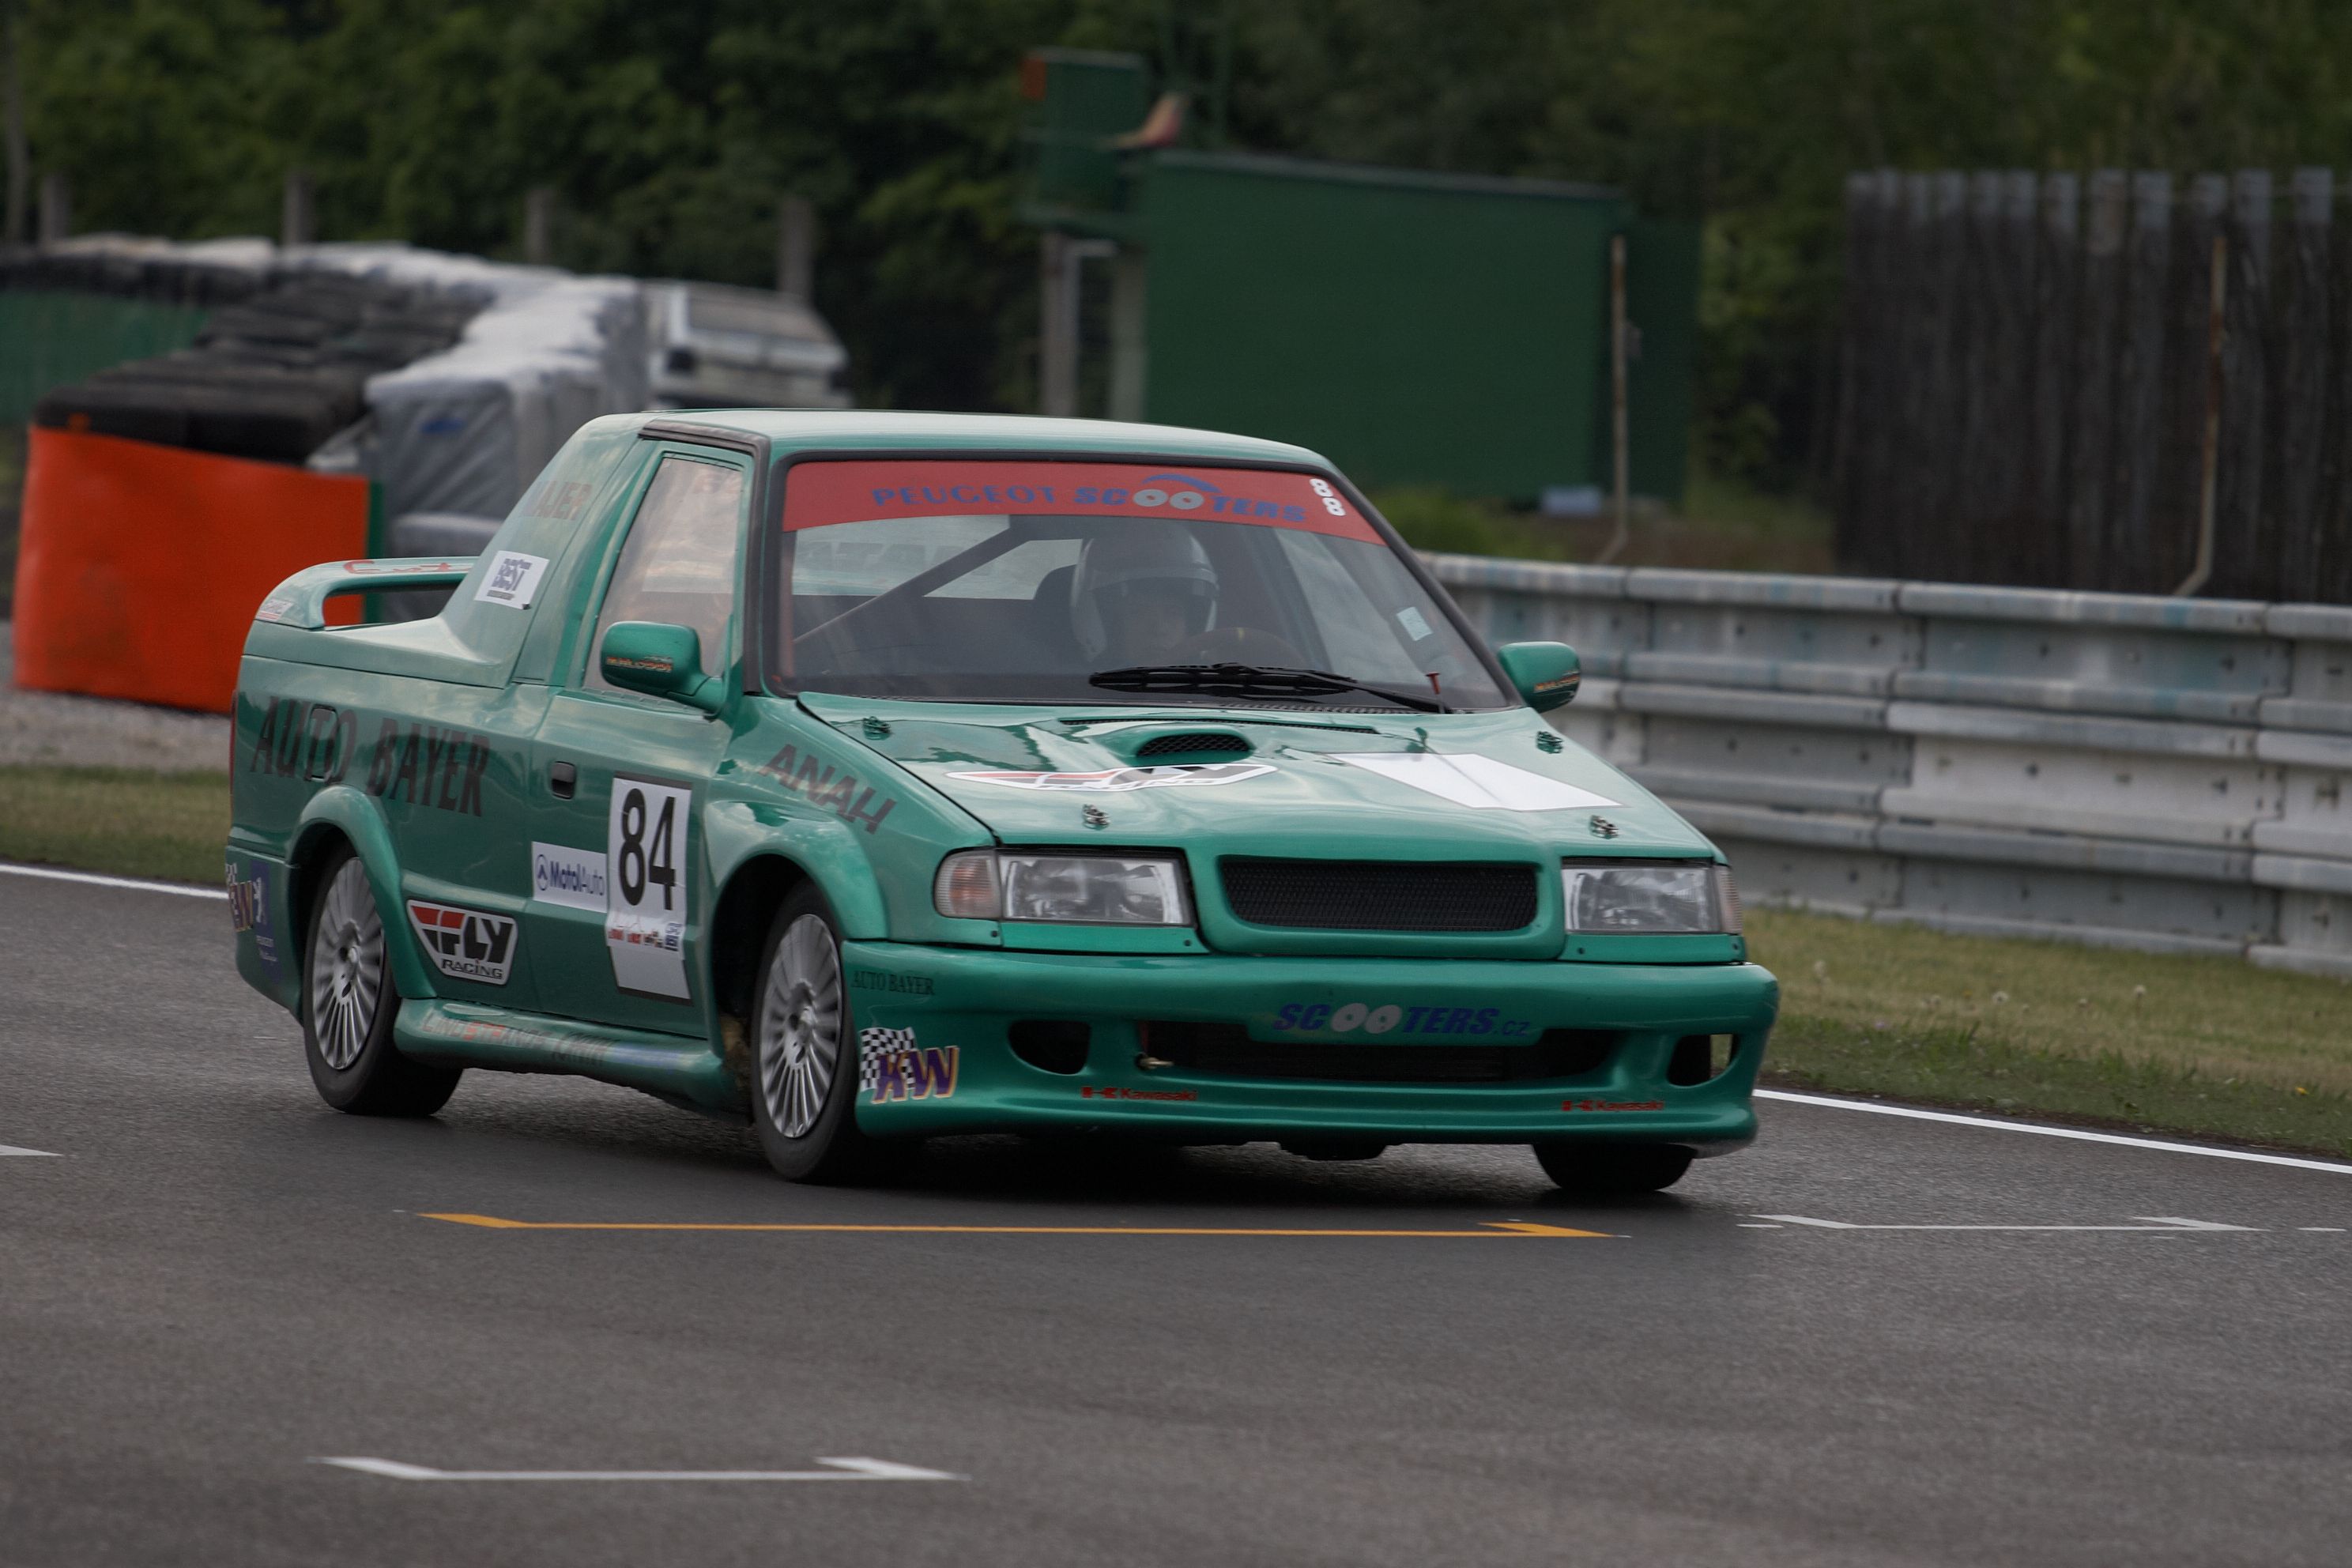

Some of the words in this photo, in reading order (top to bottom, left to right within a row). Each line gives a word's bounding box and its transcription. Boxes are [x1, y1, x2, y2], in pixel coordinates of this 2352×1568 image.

[872, 484, 1056, 506] PEUGEOT
[1073, 485, 1307, 522] SCOOTERS
[249, 695, 357, 785] AUTO
[366, 717, 491, 818] BAYER
[619, 787, 677, 911] 84
[440, 957, 503, 980] RACING
[852, 971, 886, 990] AUTO
[888, 974, 935, 996] BAYER
